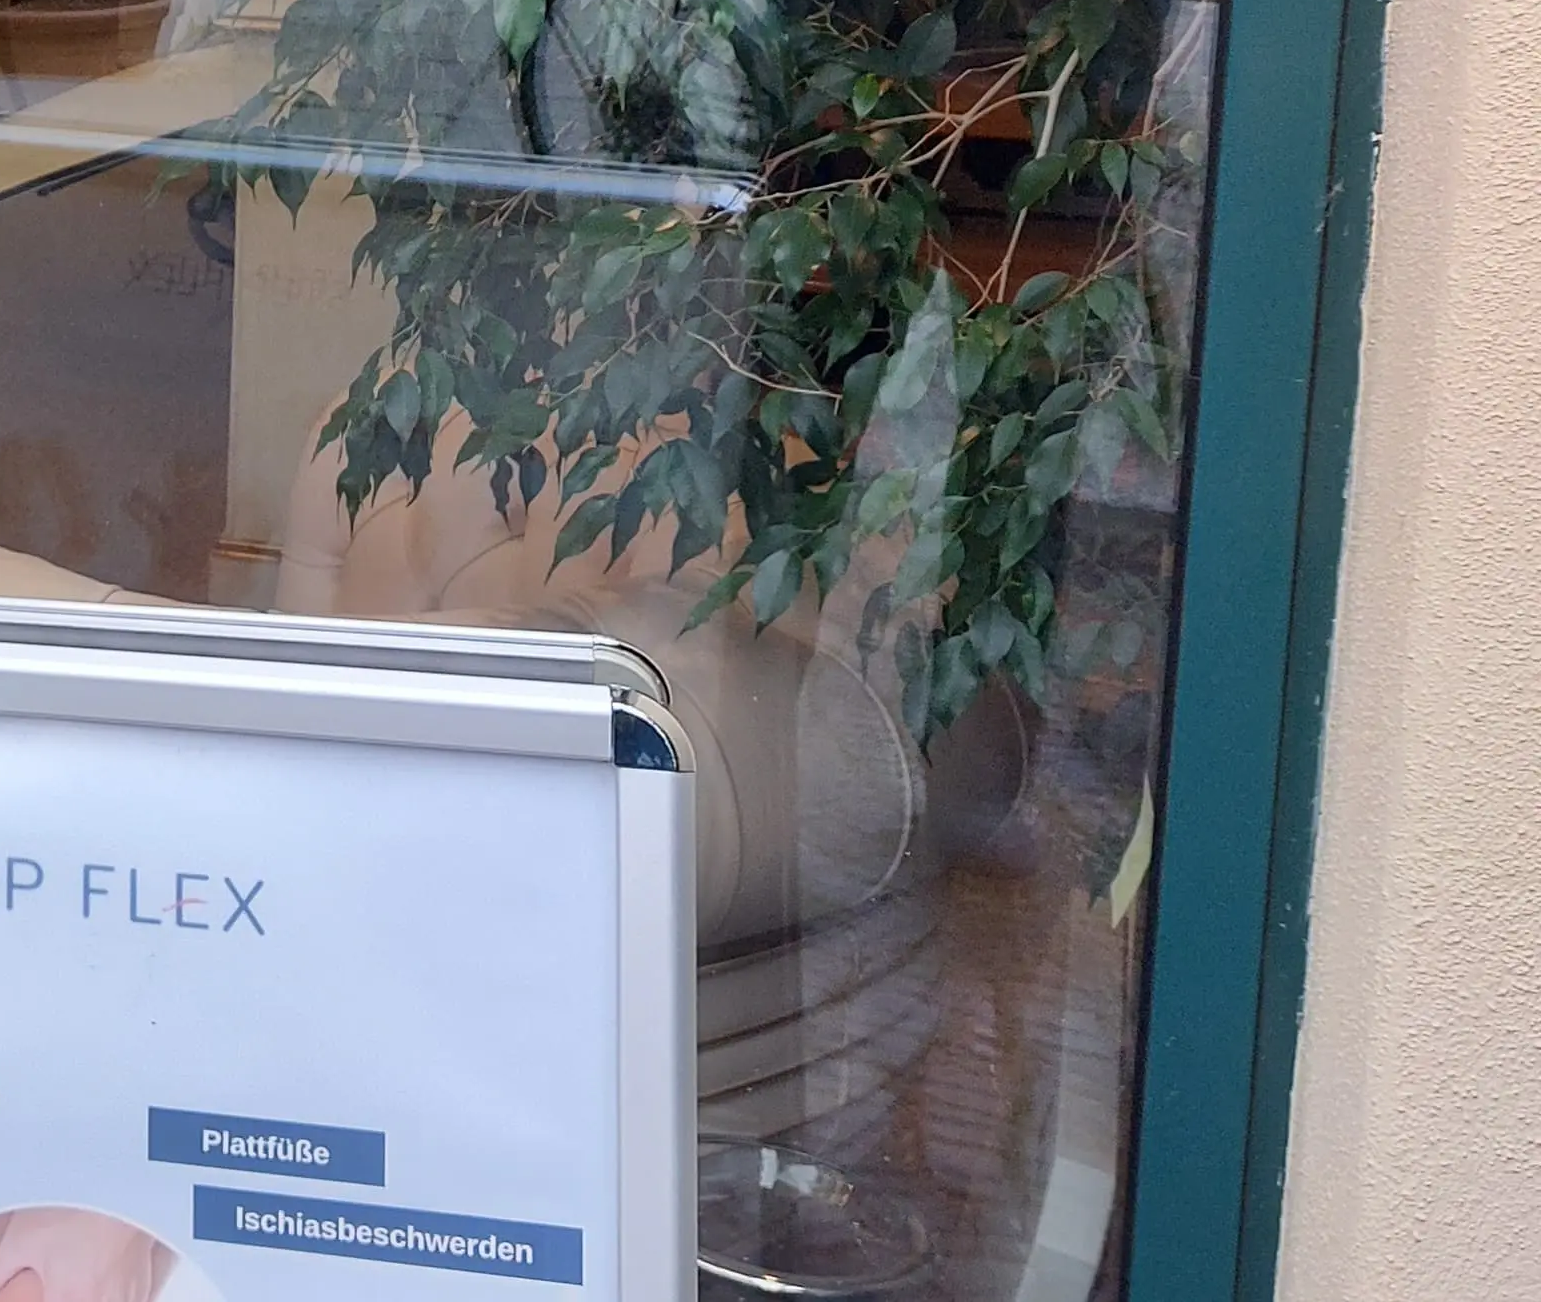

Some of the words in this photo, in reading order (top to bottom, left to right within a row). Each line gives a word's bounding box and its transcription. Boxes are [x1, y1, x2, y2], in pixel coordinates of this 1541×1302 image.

[82, 863, 266, 937] FLEX
[201, 1127, 331, 1166] Plattfüße
[235, 1204, 535, 1266] Ischiasbeschwerden
